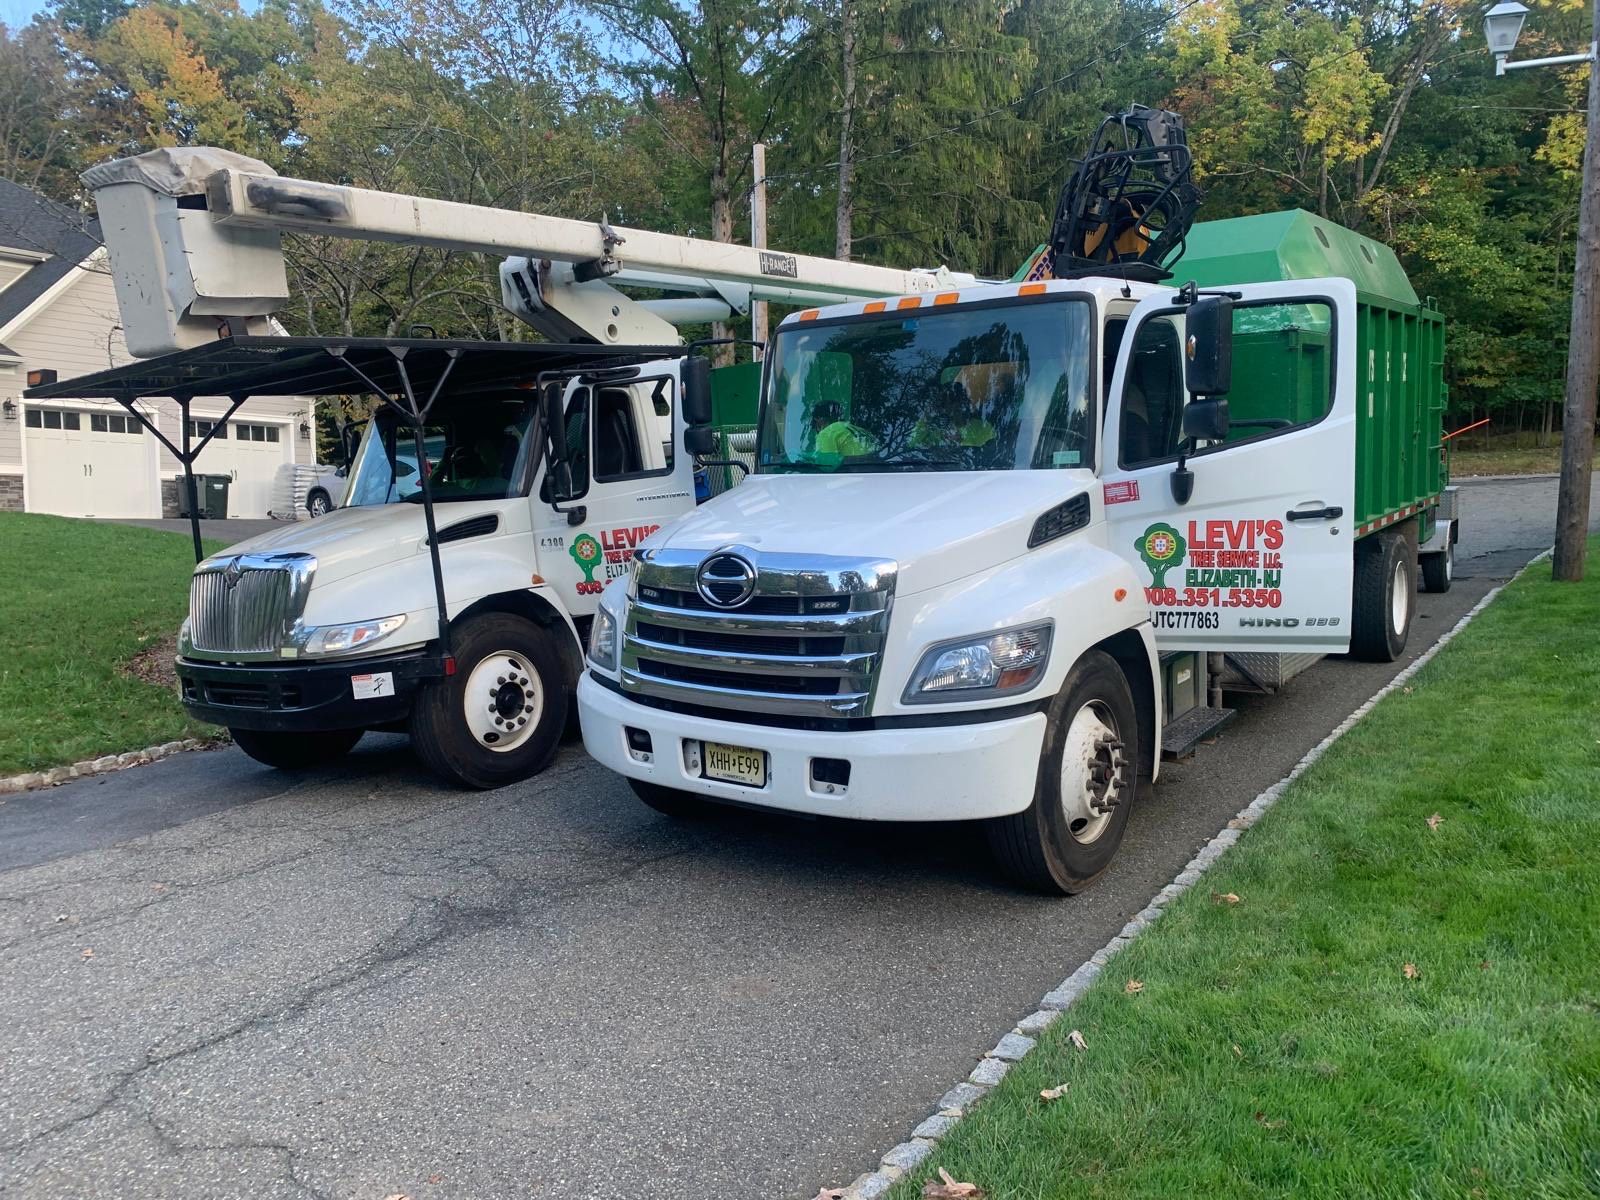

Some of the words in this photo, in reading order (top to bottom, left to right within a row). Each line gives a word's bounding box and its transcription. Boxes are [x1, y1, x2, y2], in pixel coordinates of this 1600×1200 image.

[760, 253, 796, 277] HI-RANGER
[1188, 520, 1283, 550] LEVI'S
[1189, 550, 1216, 568] TREE
[1216, 550, 1260, 569] SERVICE
[1149, 610, 1219, 629] JTC777863
[1239, 617, 1300, 628] HINO
